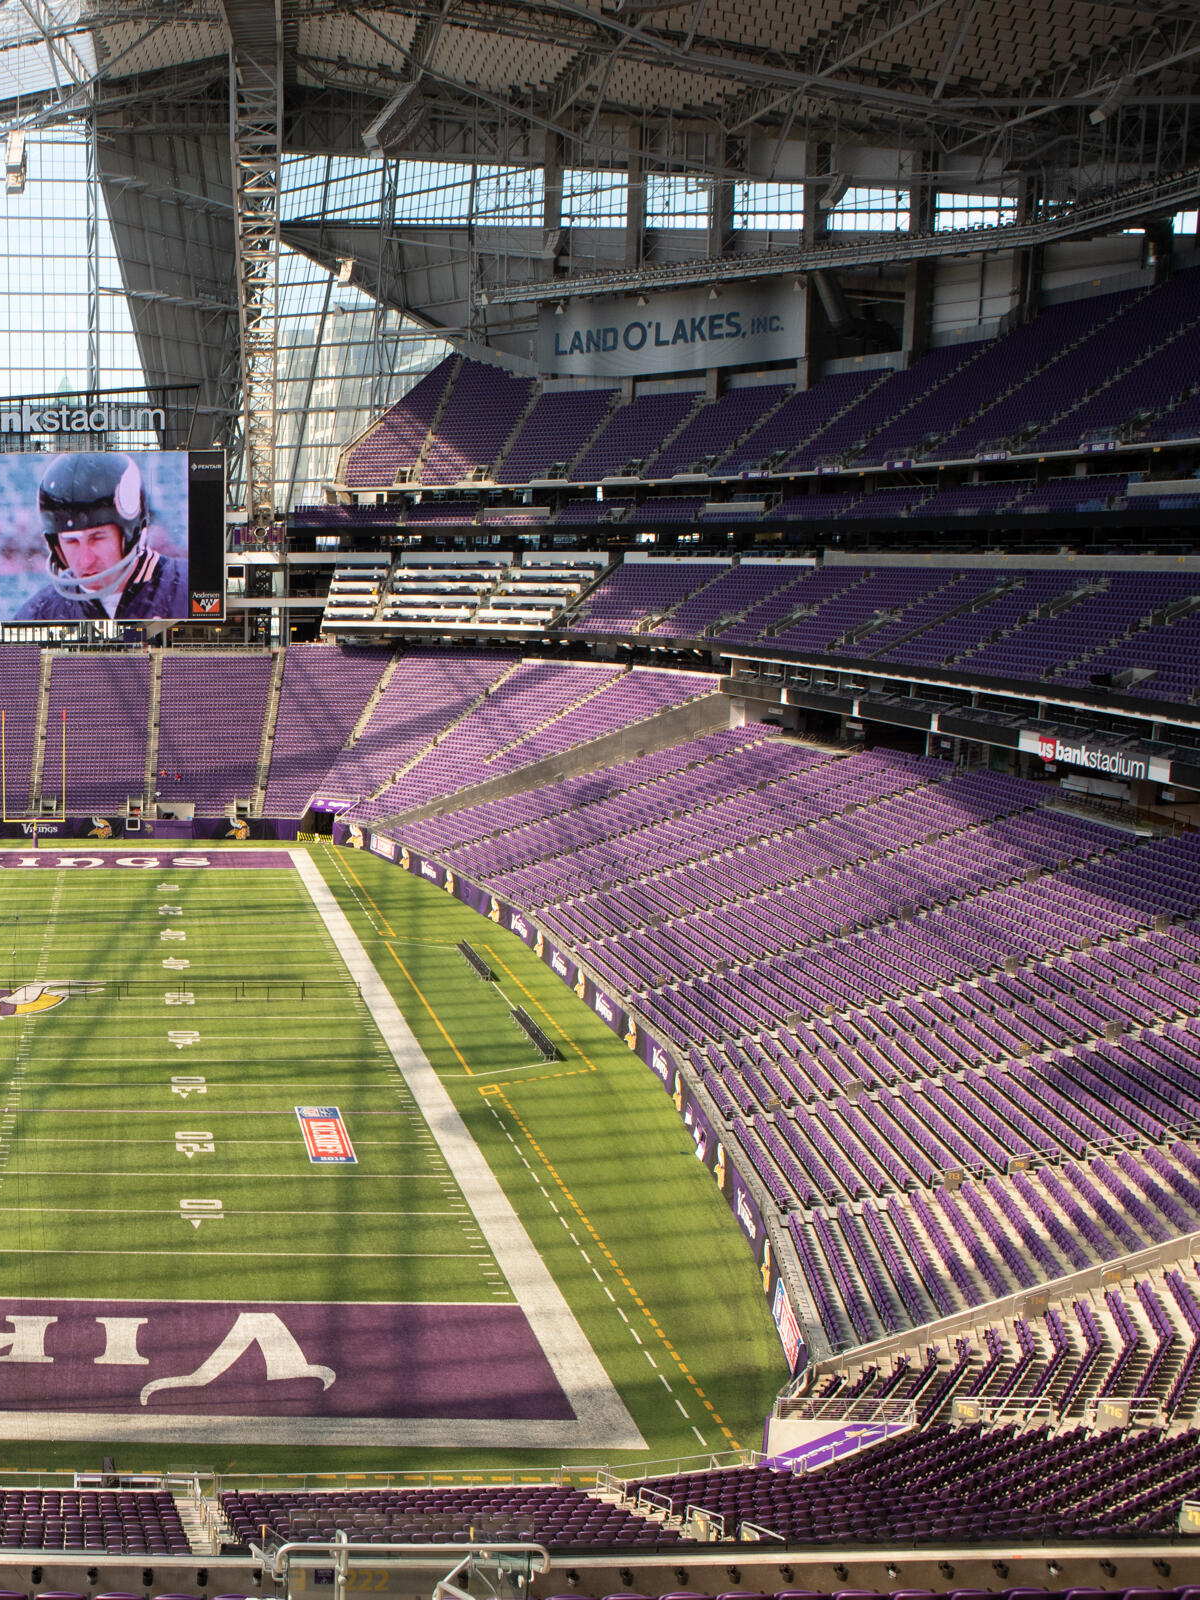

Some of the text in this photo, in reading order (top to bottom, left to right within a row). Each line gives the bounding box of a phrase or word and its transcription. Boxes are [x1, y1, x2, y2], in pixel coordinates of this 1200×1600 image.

[555, 311, 785, 357] LAND O'LAKES, INC.
[309, 1121, 345, 1155] KICKOFF
[957, 1403, 975, 1418] 116
[1103, 1404, 1124, 1420] 116
